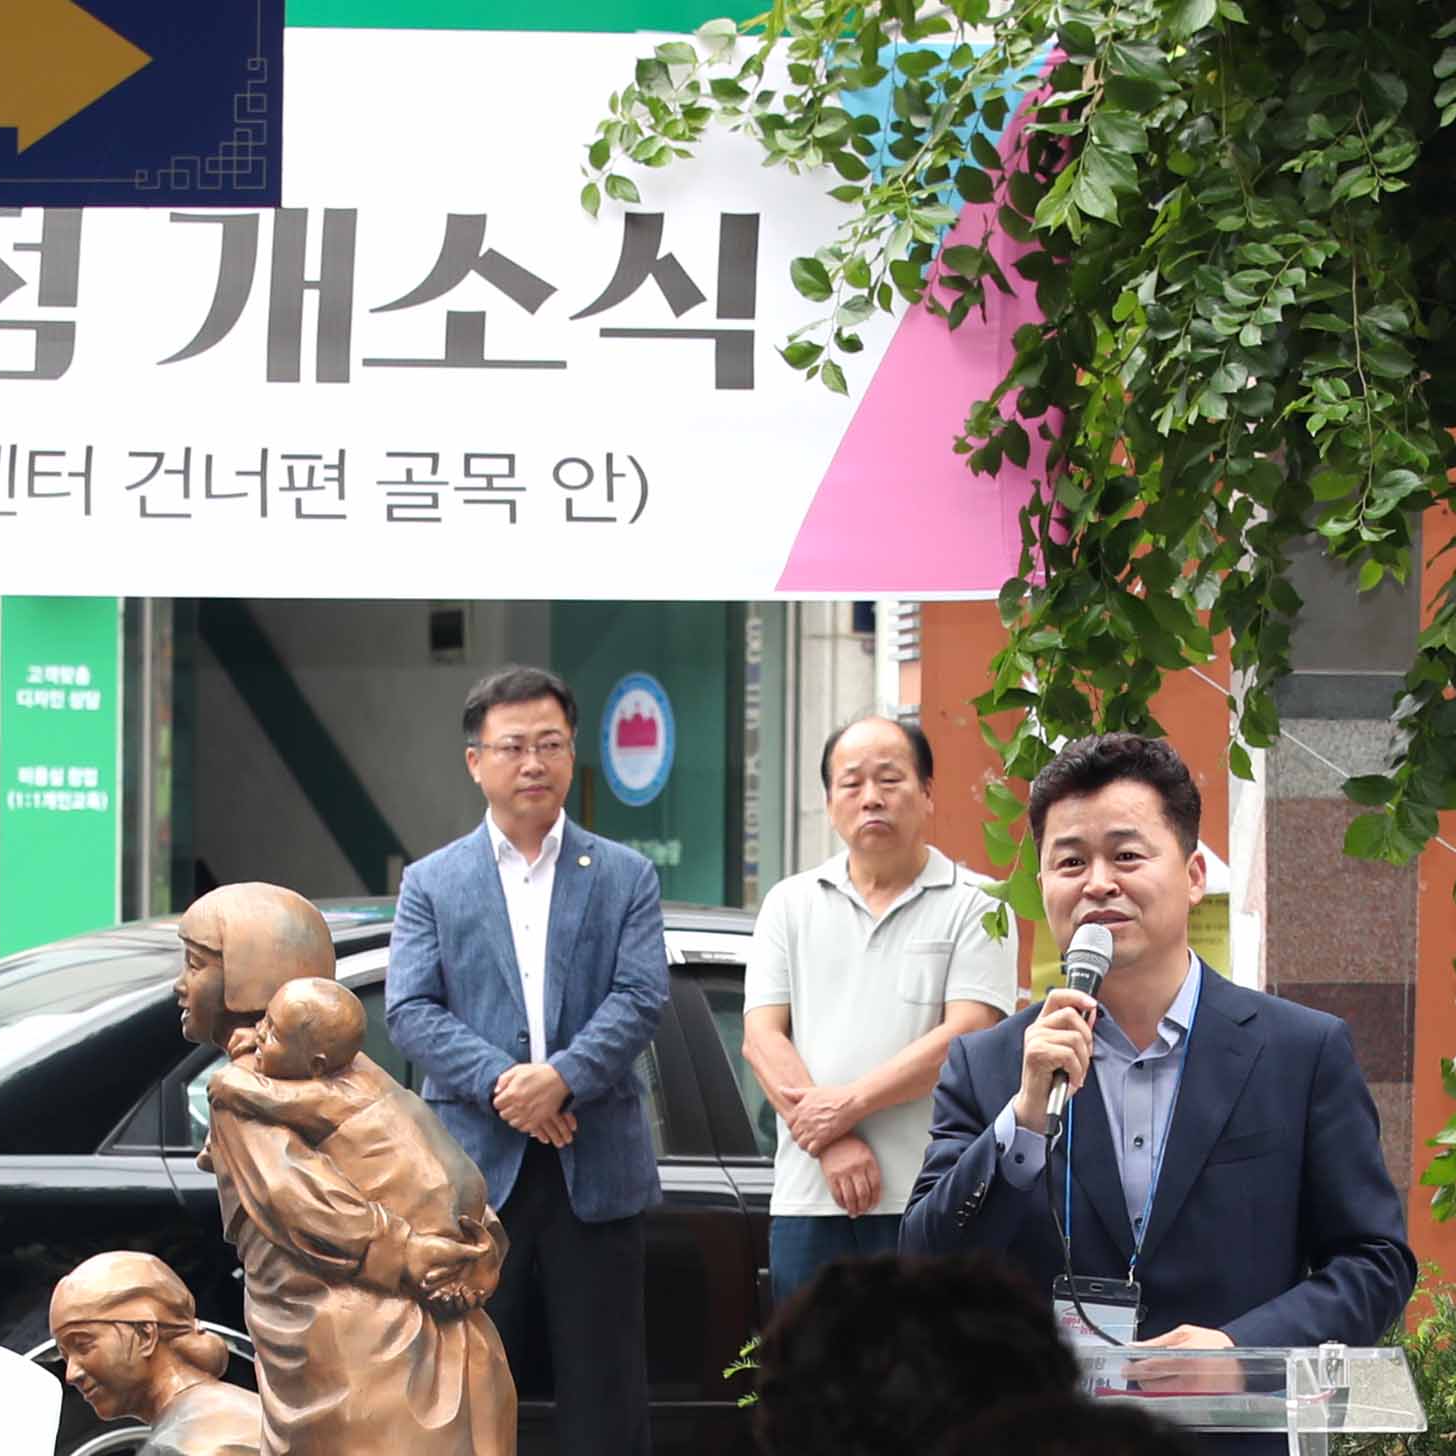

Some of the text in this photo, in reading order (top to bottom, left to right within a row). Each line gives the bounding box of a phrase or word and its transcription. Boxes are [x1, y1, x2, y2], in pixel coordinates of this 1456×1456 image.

[156, 207, 760, 390] 개소식
[125, 447, 348, 520] 건너편
[376, 451, 527, 524] 골목
[552, 451, 649, 524] 안)
